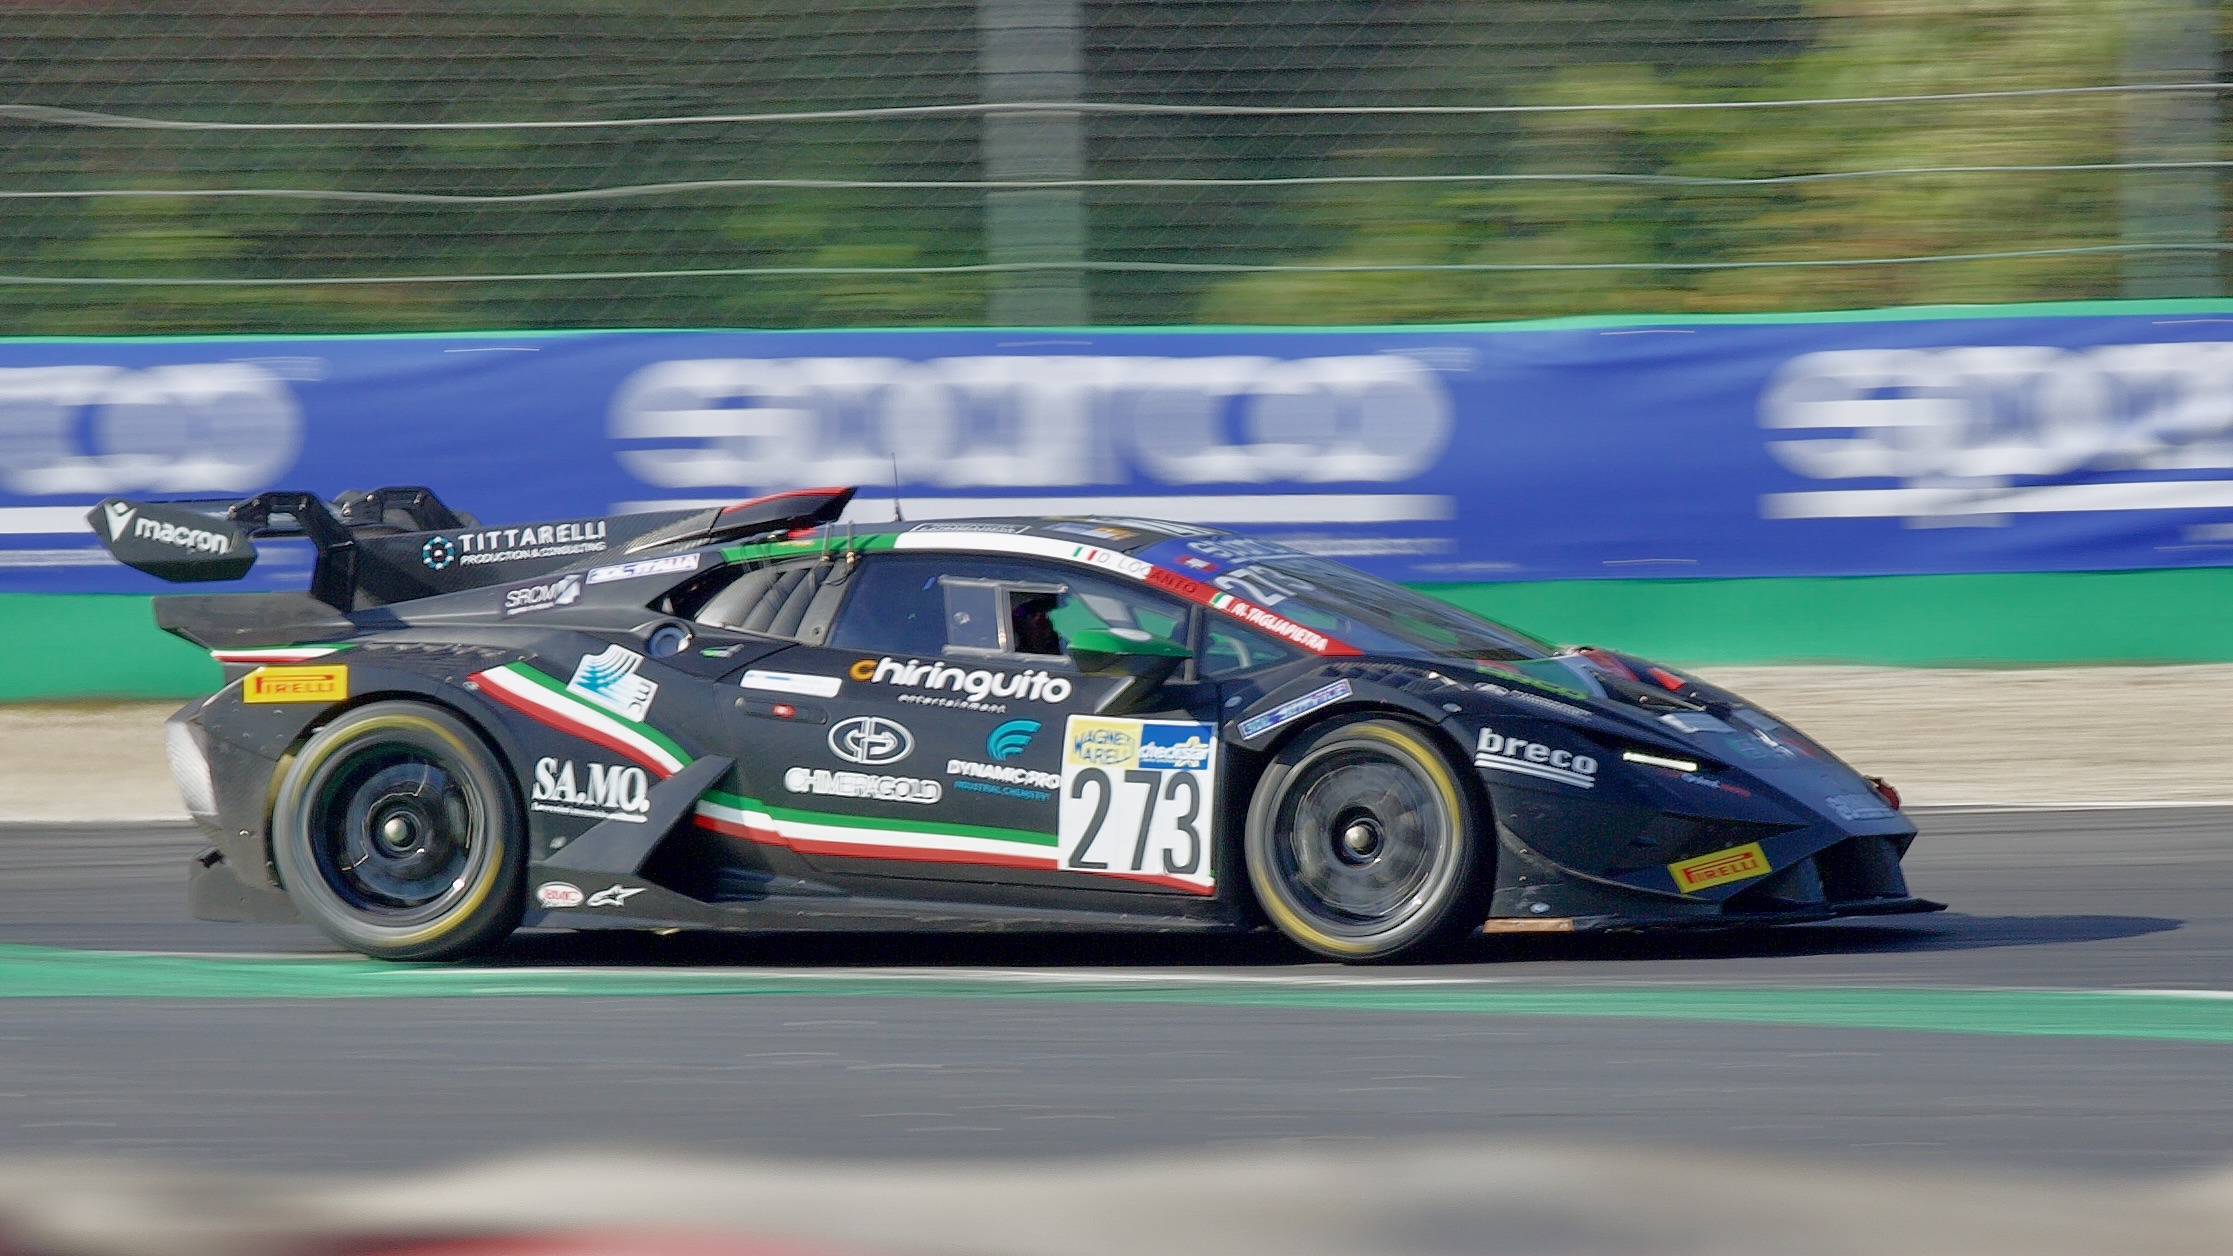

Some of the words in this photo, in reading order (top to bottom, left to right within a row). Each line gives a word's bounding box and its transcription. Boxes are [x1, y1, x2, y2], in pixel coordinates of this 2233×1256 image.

[134, 517, 229, 555] macron
[458, 520, 606, 553] TITTARELLI
[255, 674, 335, 695] PIRELLI
[849, 656, 1073, 703] chiringuito
[898, 694, 1007, 714] entertainment
[1477, 726, 1599, 775] breco
[531, 757, 651, 813] SA.MO.
[1068, 767, 1201, 875] 273
[1681, 851, 1760, 885] PIRELLI
